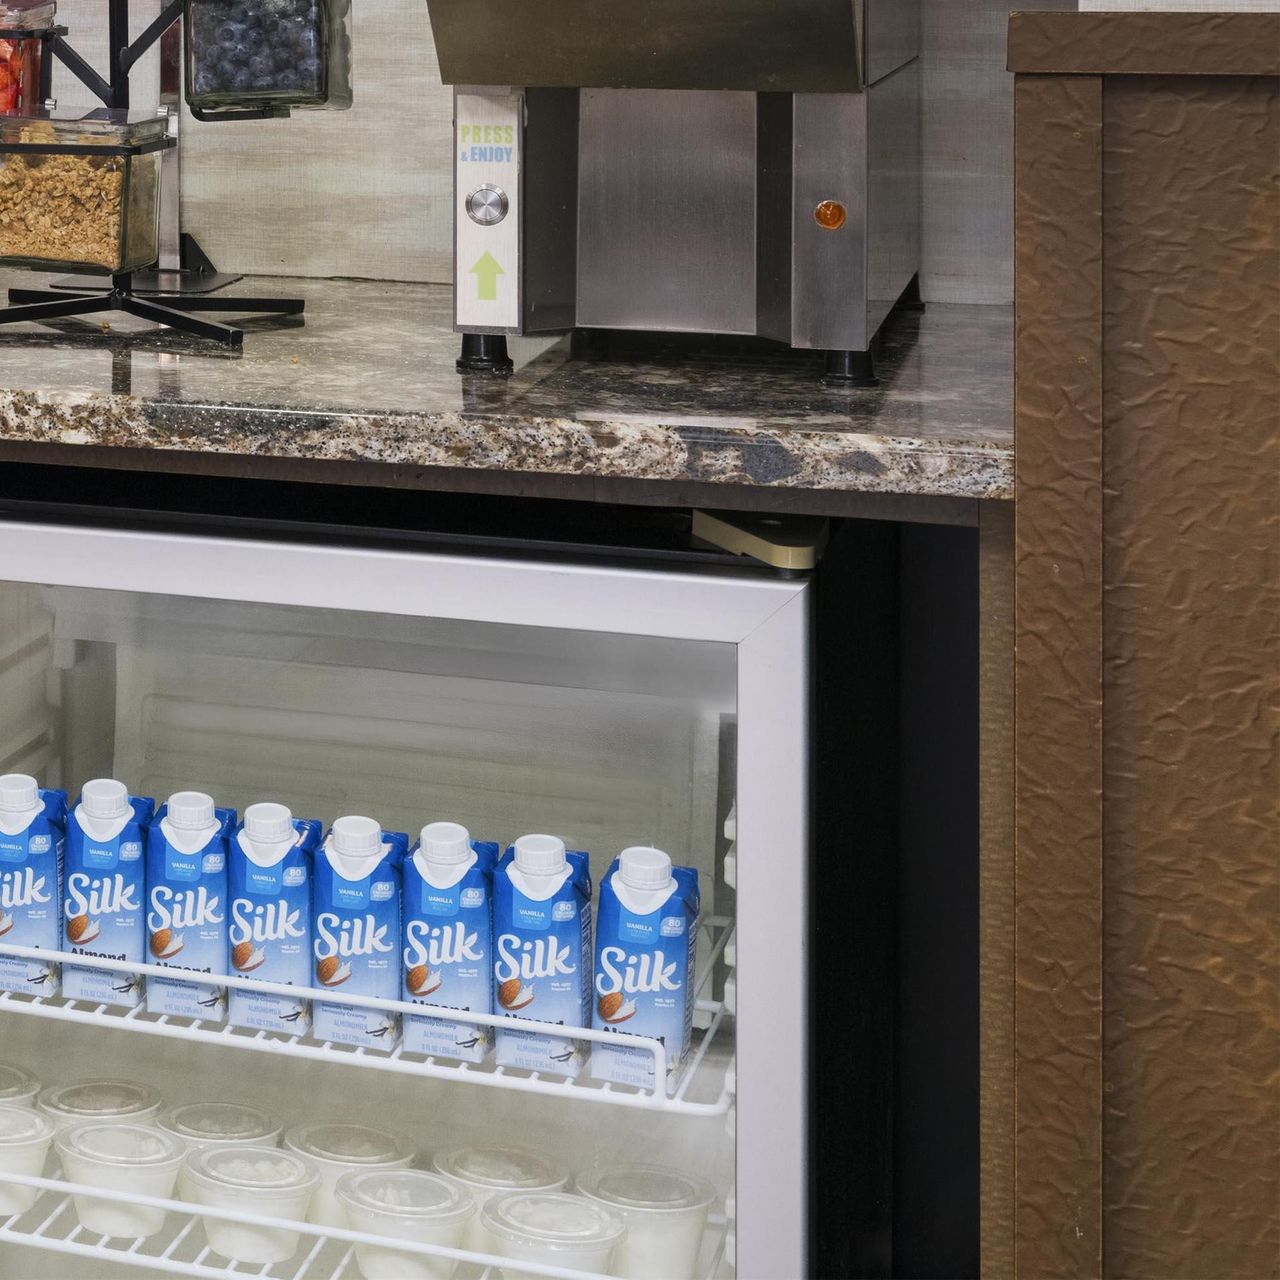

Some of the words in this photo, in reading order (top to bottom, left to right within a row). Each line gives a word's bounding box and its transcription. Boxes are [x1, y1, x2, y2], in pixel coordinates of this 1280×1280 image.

[461, 124, 514, 144] PRESS
[461, 151, 469, 162] &
[470, 146, 513, 163] ENJOY
[35, 837, 46, 845] 80
[0, 843, 23, 851] VANILLA
[89, 849, 112, 857] VANILLA
[171, 862, 196, 870] VANILLA
[252, 874, 276, 883] VANILLA
[377, 883, 390, 891] 80
[64, 873, 140, 919] Silk
[338, 889, 364, 898] VANILLA
[467, 890, 480, 898] 80
[428, 895, 453, 905] VANILLA
[147, 886, 225, 933] Silk
[559, 903, 572, 911] 80
[519, 909, 545, 918] VANILLA
[229, 898, 306, 945] Silk
[667, 919, 681, 927] 80
[626, 922, 653, 932] VANILLA
[314, 912, 394, 960] Silk
[403, 920, 484, 969] Silk
[494, 934, 577, 983] Silk
[595, 946, 682, 995] Silk
